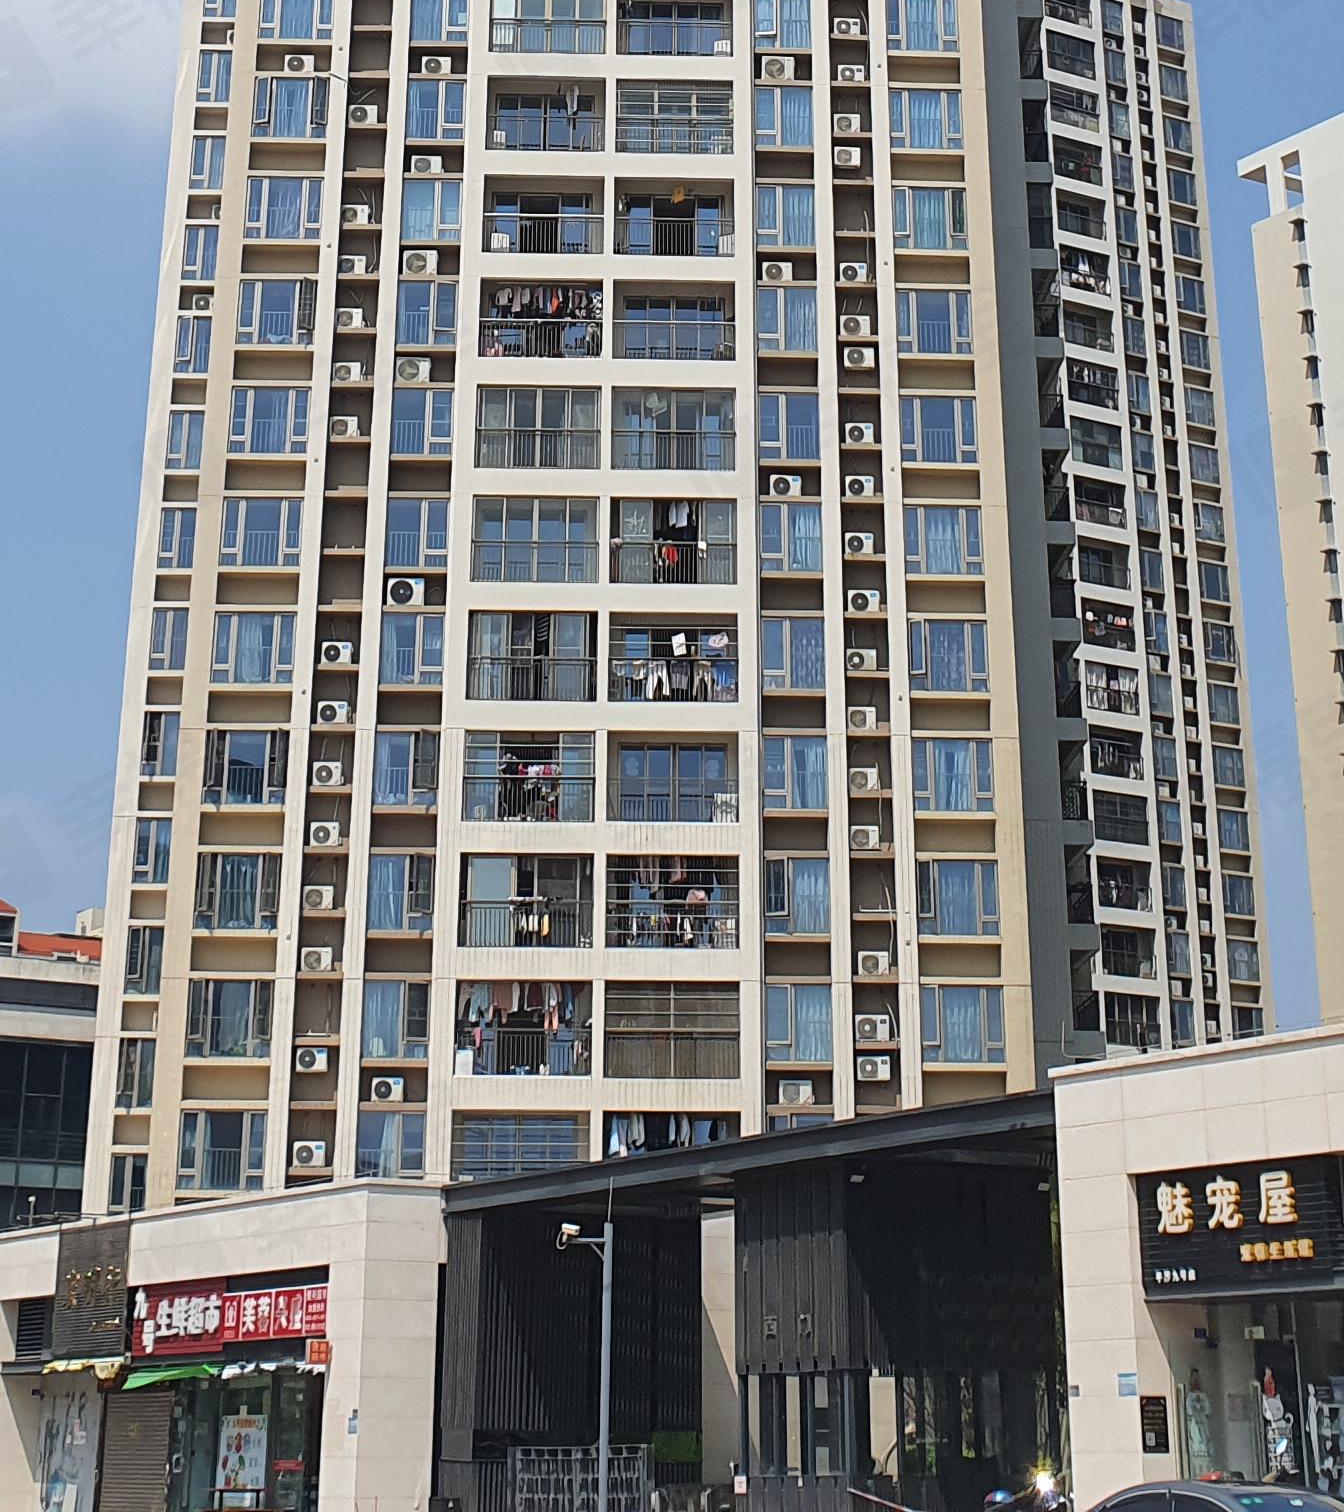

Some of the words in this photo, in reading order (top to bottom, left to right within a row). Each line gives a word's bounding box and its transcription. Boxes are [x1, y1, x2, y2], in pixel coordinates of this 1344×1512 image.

[1156, 1169, 1299, 1234] 魅宠屋
[156, 1293, 221, 1337] 生鲜超市
